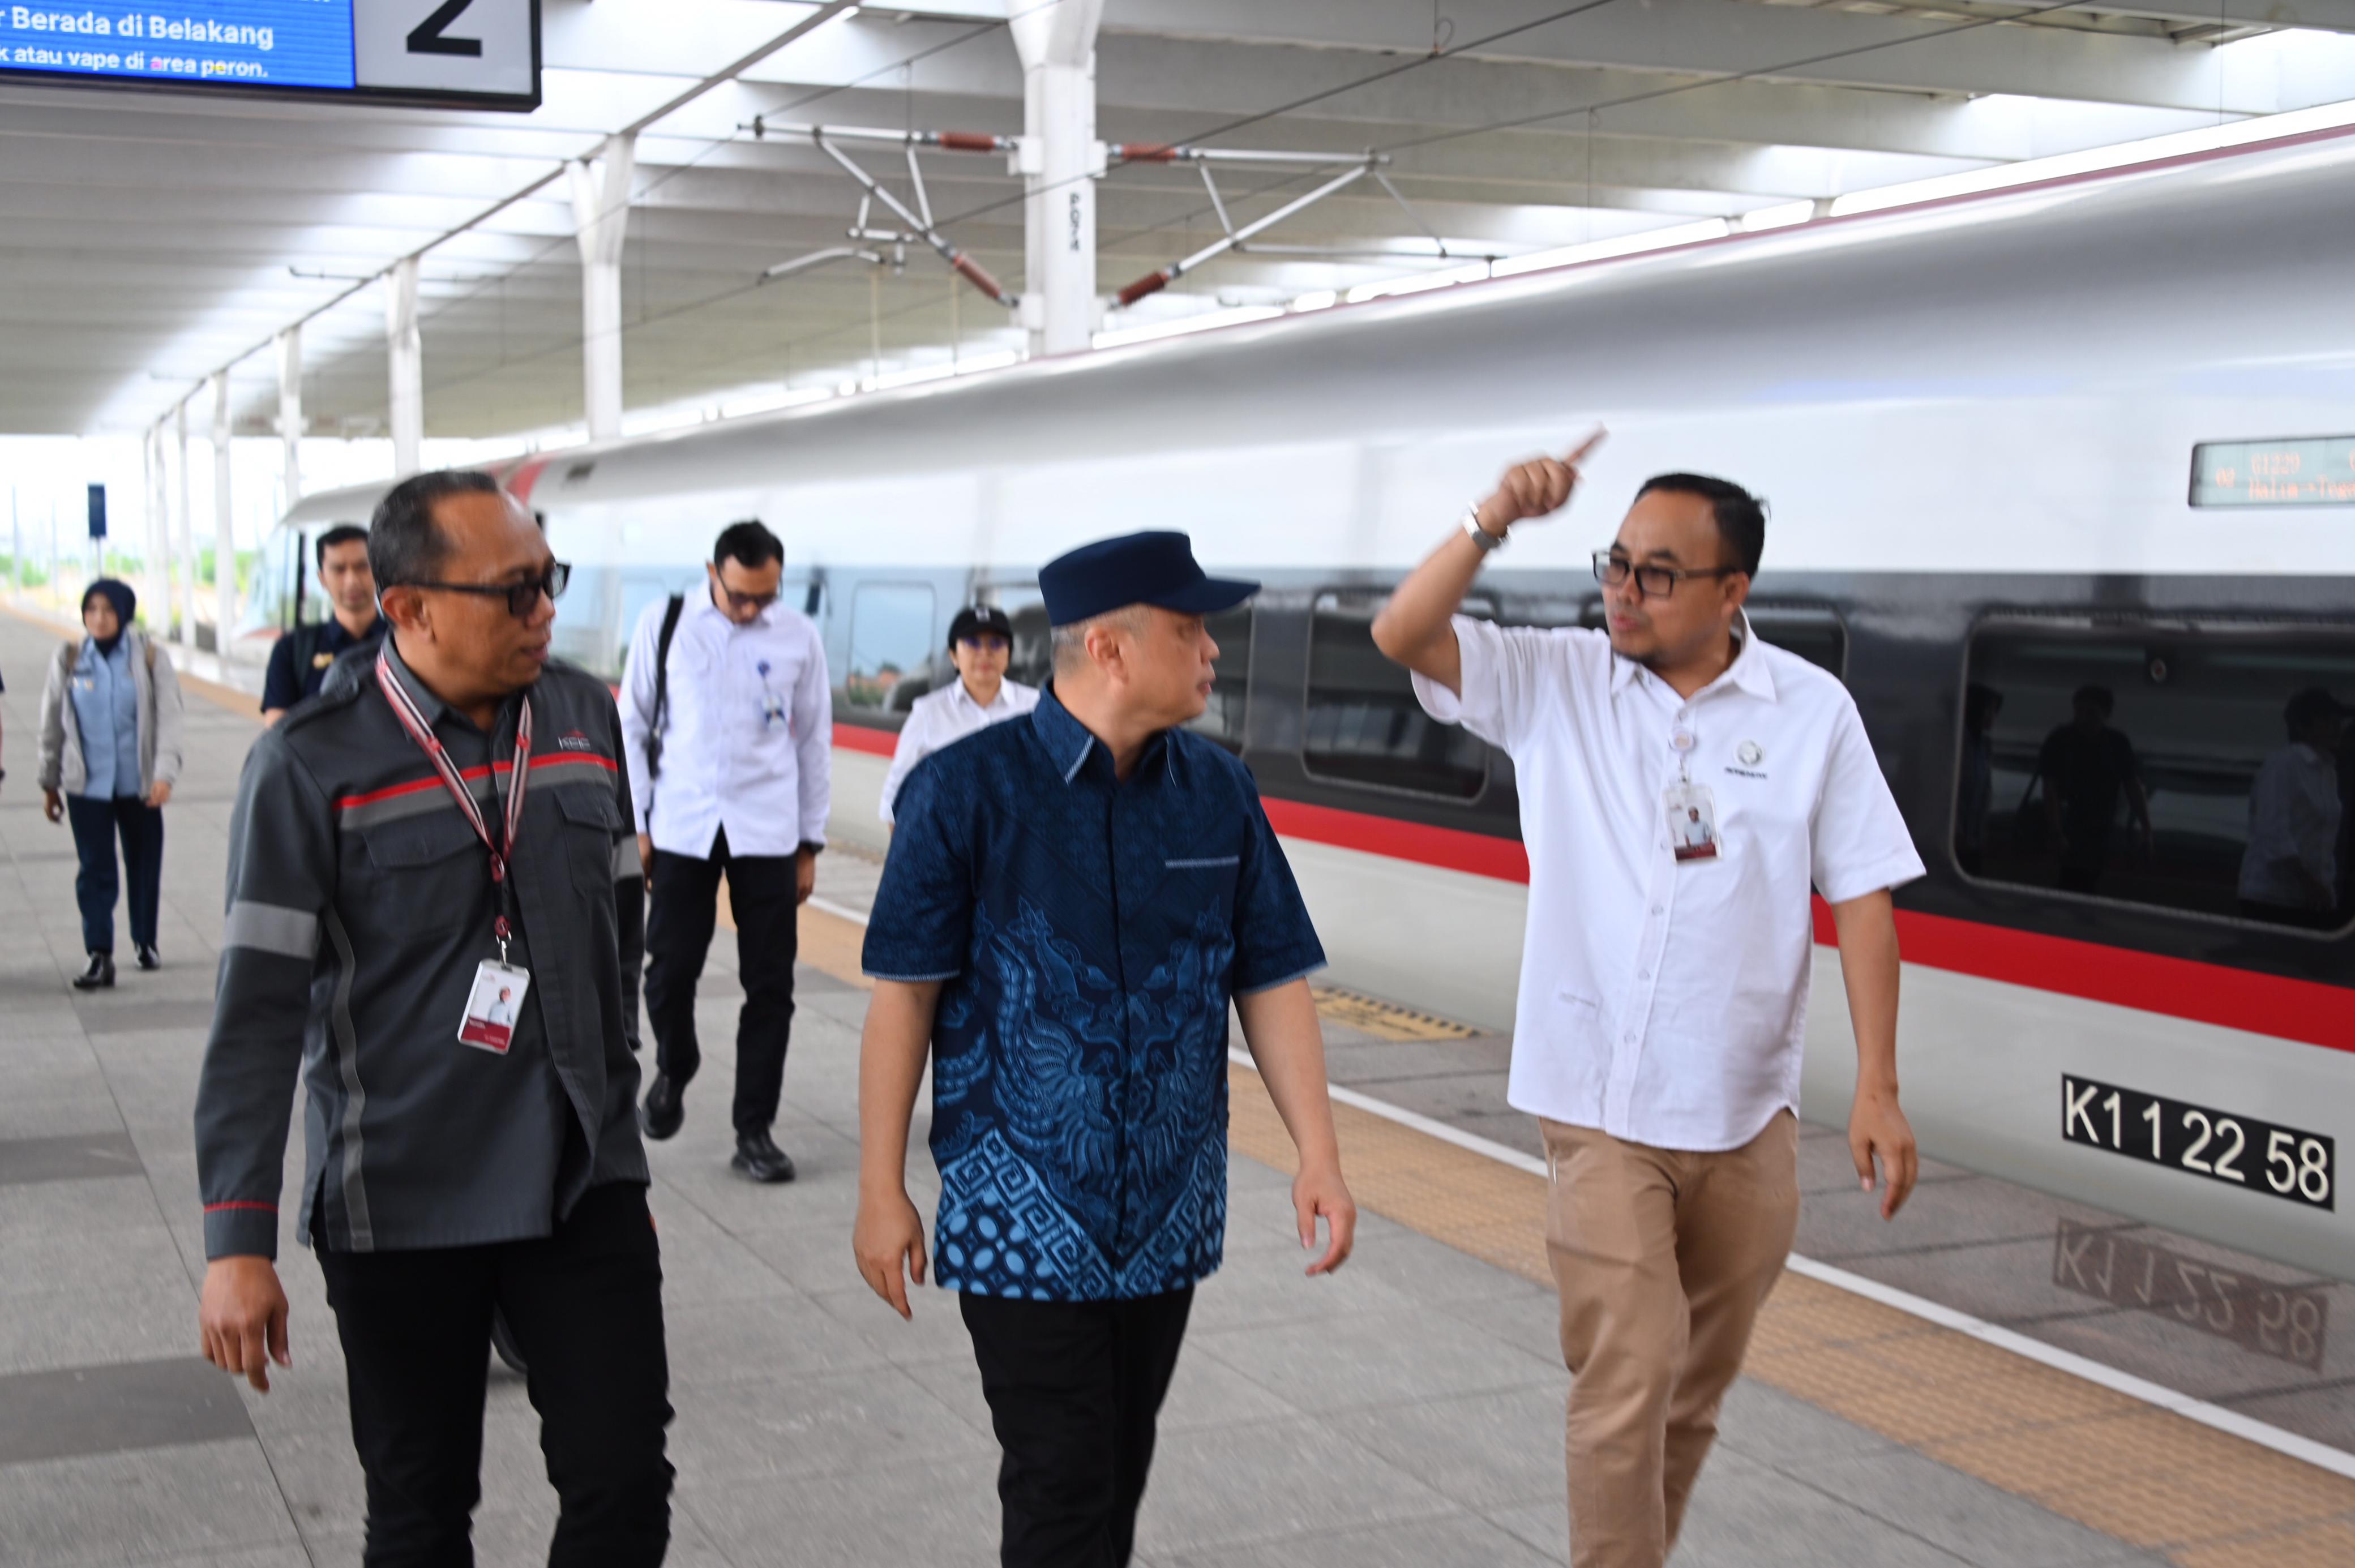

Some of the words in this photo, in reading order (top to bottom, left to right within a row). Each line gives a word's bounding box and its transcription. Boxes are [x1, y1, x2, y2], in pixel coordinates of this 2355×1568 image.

[12, 5, 111, 35] Berada
[117, 13, 144, 37] di
[149, 15, 274, 51] Belakang
[14, 46, 63, 65] atau
[67, 51, 120, 71] vape
[125, 50, 145, 70] di
[150, 57, 197, 73] area
[201, 58, 269, 78] peron.
[2066, 1079, 2121, 1150] K1
[2142, 1100, 2161, 1160] 1
[2181, 1109, 2246, 1182] 22
[2265, 1130, 2330, 1202] 58
